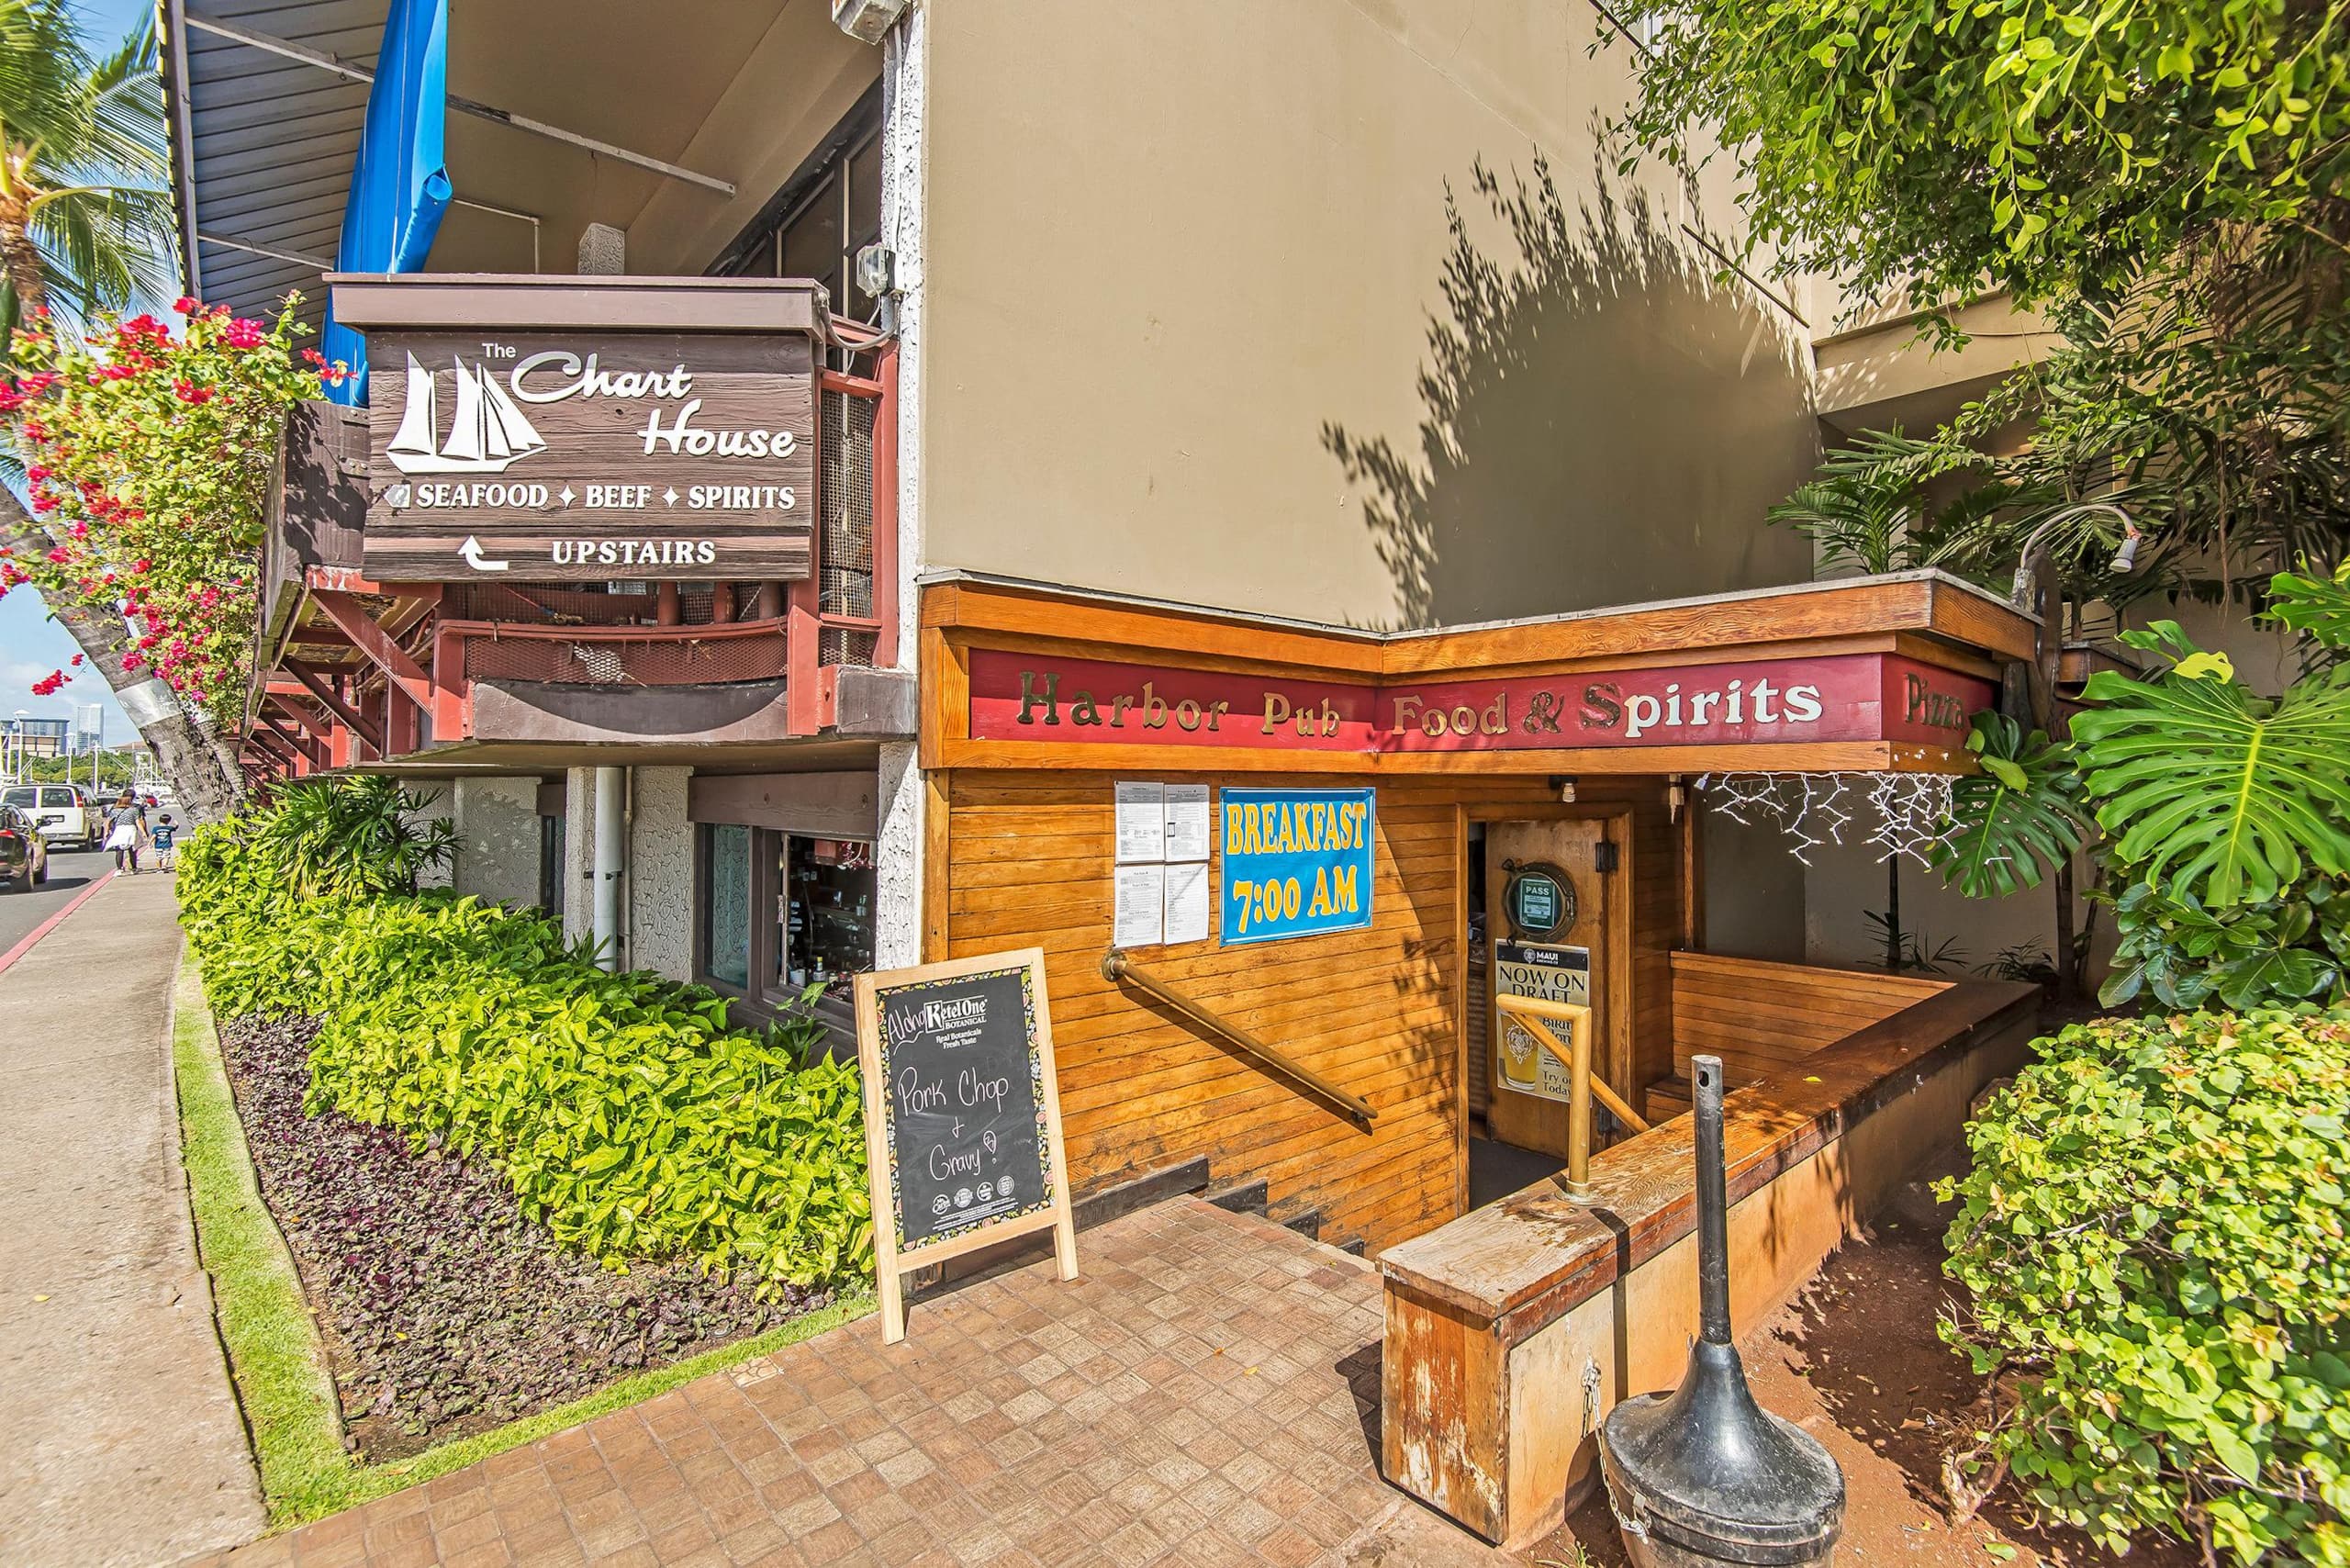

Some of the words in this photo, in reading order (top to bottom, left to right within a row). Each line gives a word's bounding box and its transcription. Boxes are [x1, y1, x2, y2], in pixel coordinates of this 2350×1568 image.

[482, 342, 516, 359] The
[510, 350, 694, 404] Chart
[637, 398, 799, 459] House
[416, 484, 549, 509] SEAFOOD
[585, 485, 653, 509] BEEF
[688, 485, 796, 510] SPIRITS
[551, 541, 716, 565] UPSTAIRS
[1016, 671, 1229, 731] Harbor
[1260, 691, 1341, 737] Pub
[1392, 692, 1508, 736] Food
[1522, 691, 1564, 734] &
[1580, 678, 1823, 738] Spirits
[1904, 673, 1964, 730] Pizza
[1226, 802, 1367, 855] BREAKFAST
[1233, 877, 1302, 934] 7:00
[1307, 865, 1359, 917] AM
[1526, 886, 1550, 896] PASS
[1537, 951, 1559, 960] MAUI
[1500, 966, 1548, 986] NOW
[1554, 973, 1585, 991] ON
[1513, 984, 1572, 1003] DRAFT
[888, 1004, 925, 1044] Aloha
[935, 1034, 951, 1044] Real
[951, 1027, 982, 1041] Botanicals
[945, 1015, 987, 1030] BOTANICAL
[943, 1040, 960, 1050] Fresh
[961, 1036, 977, 1046] Taste
[1543, 1071, 1559, 1084] Try
[898, 1066, 946, 1117] Pork
[958, 1066, 1009, 1114] Chop
